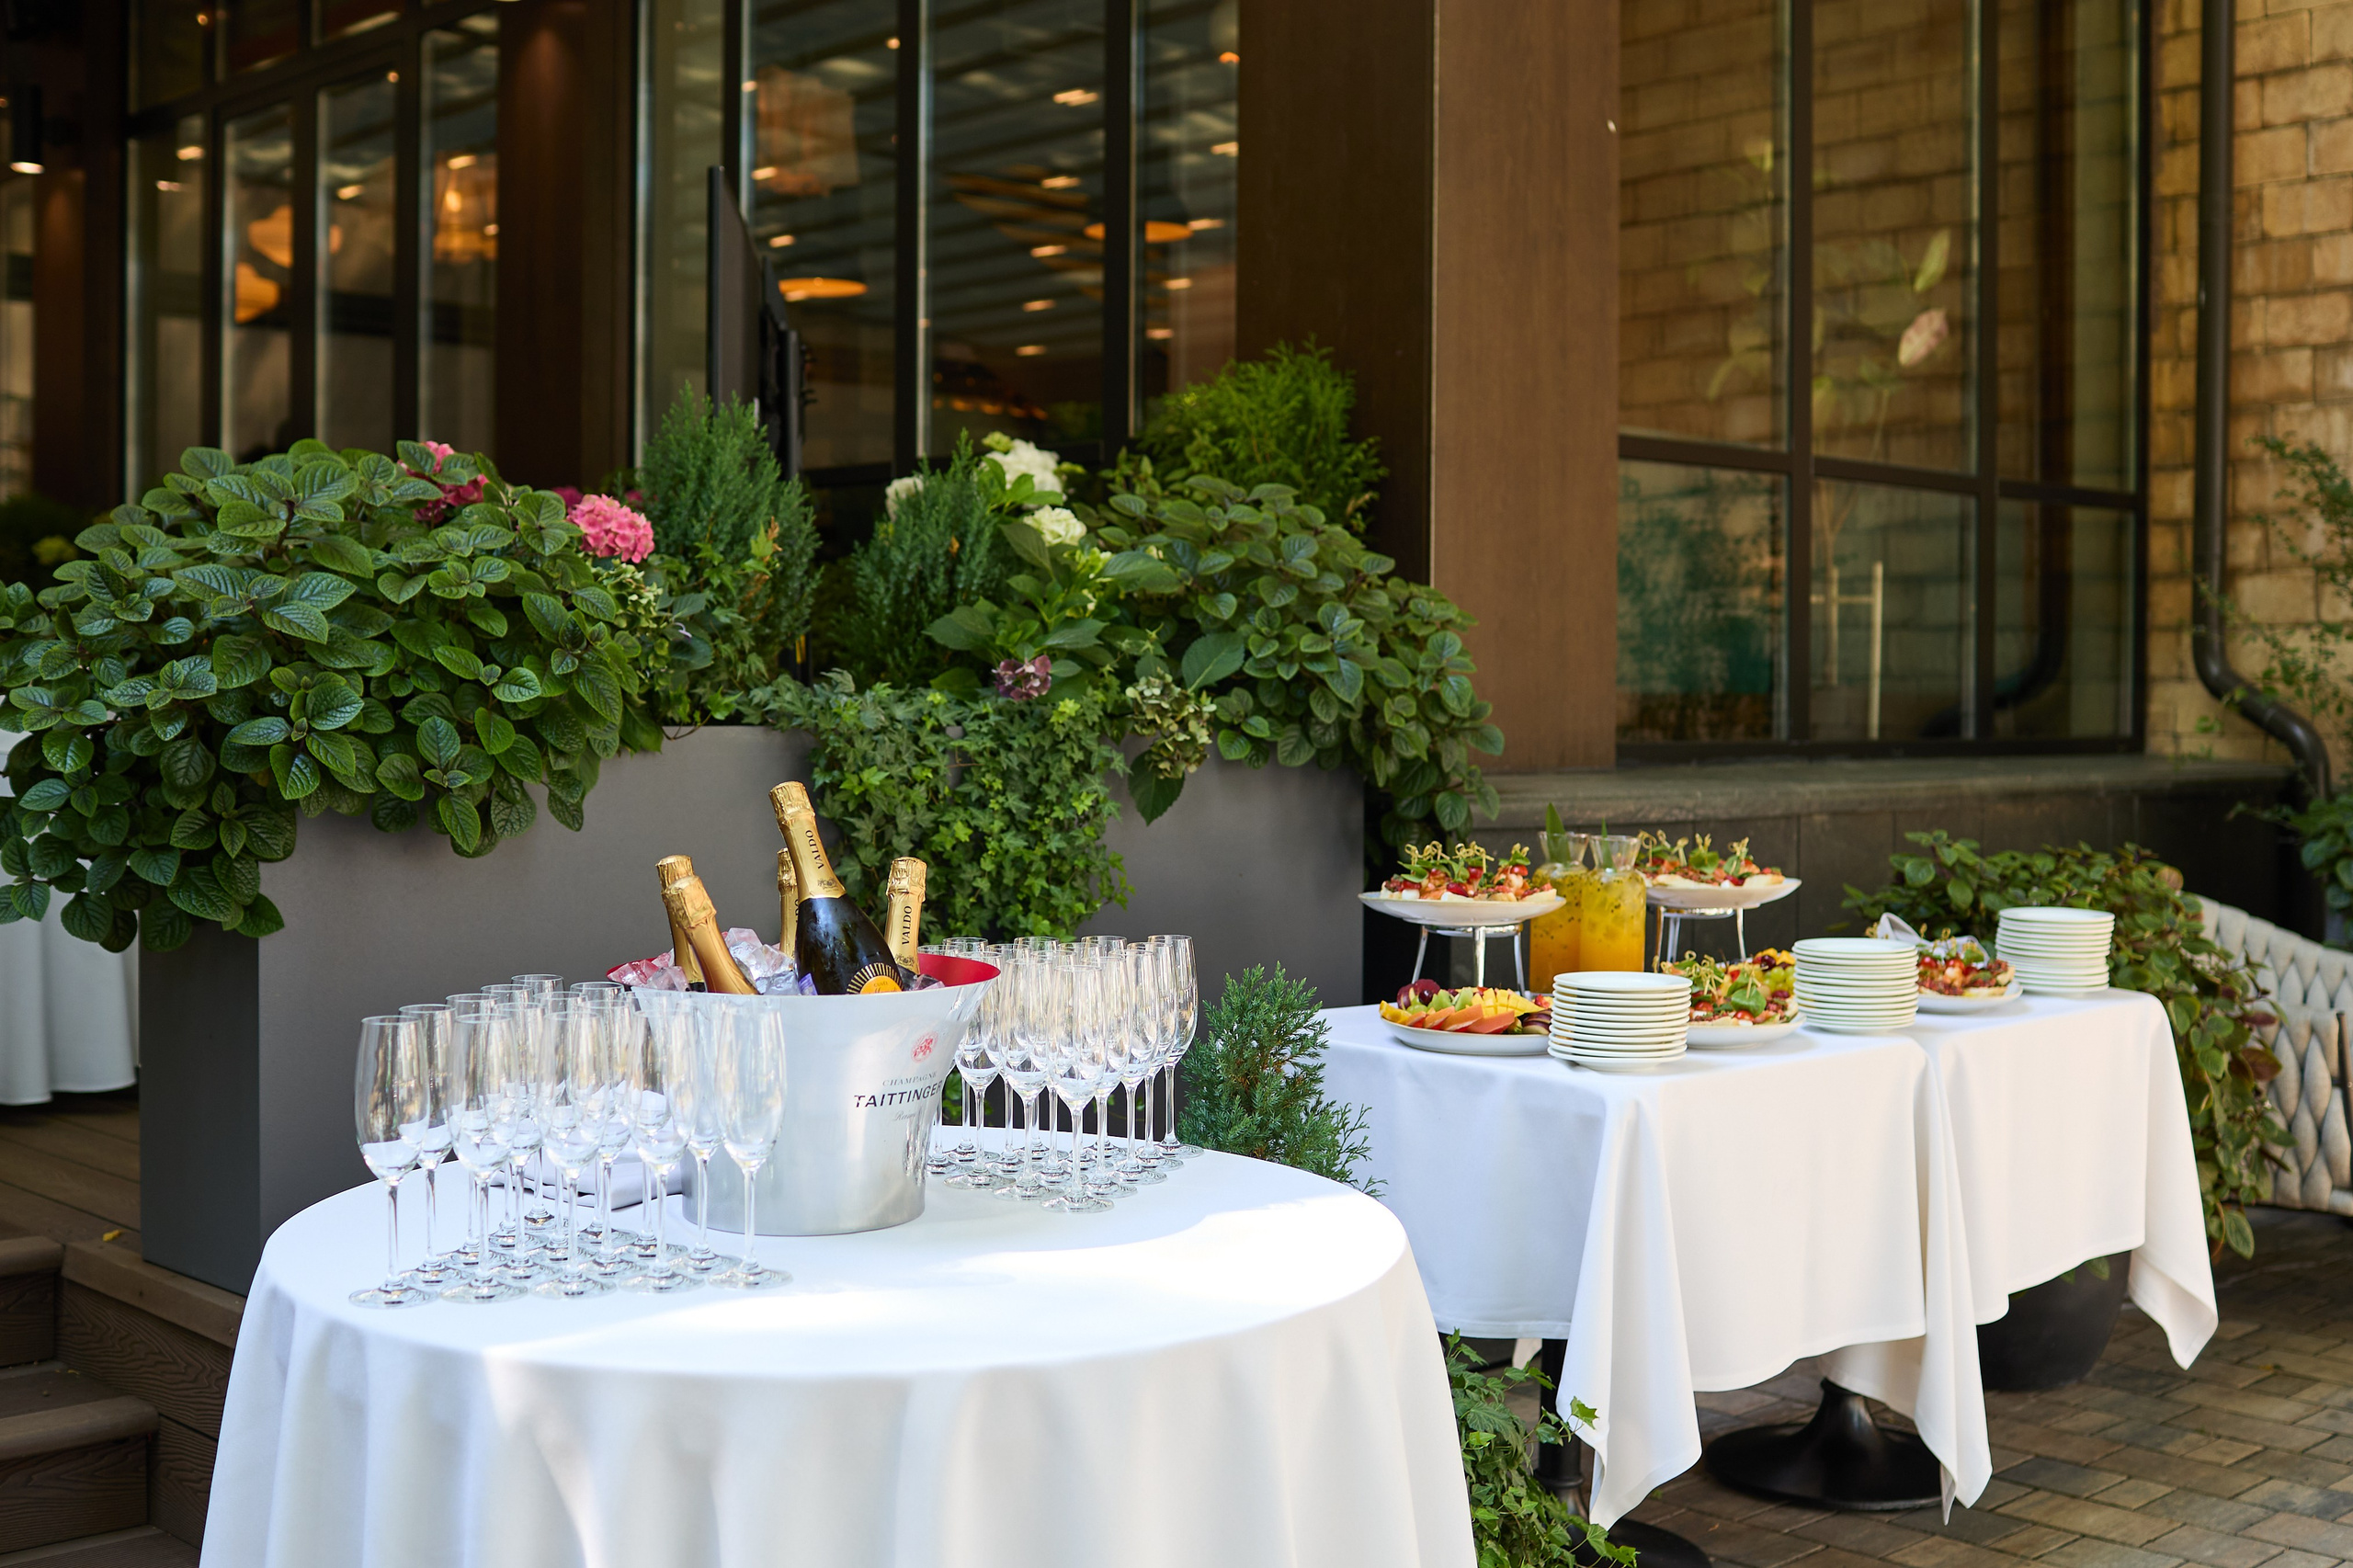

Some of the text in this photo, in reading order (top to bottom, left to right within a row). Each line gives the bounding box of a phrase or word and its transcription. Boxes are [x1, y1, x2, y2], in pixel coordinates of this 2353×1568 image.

[805, 830, 824, 869] VALDO
[902, 905, 913, 945] VALDO
[854, 1080, 943, 1108] TAITTINGER
[882, 1071, 938, 1086] CHAMPAGNE
